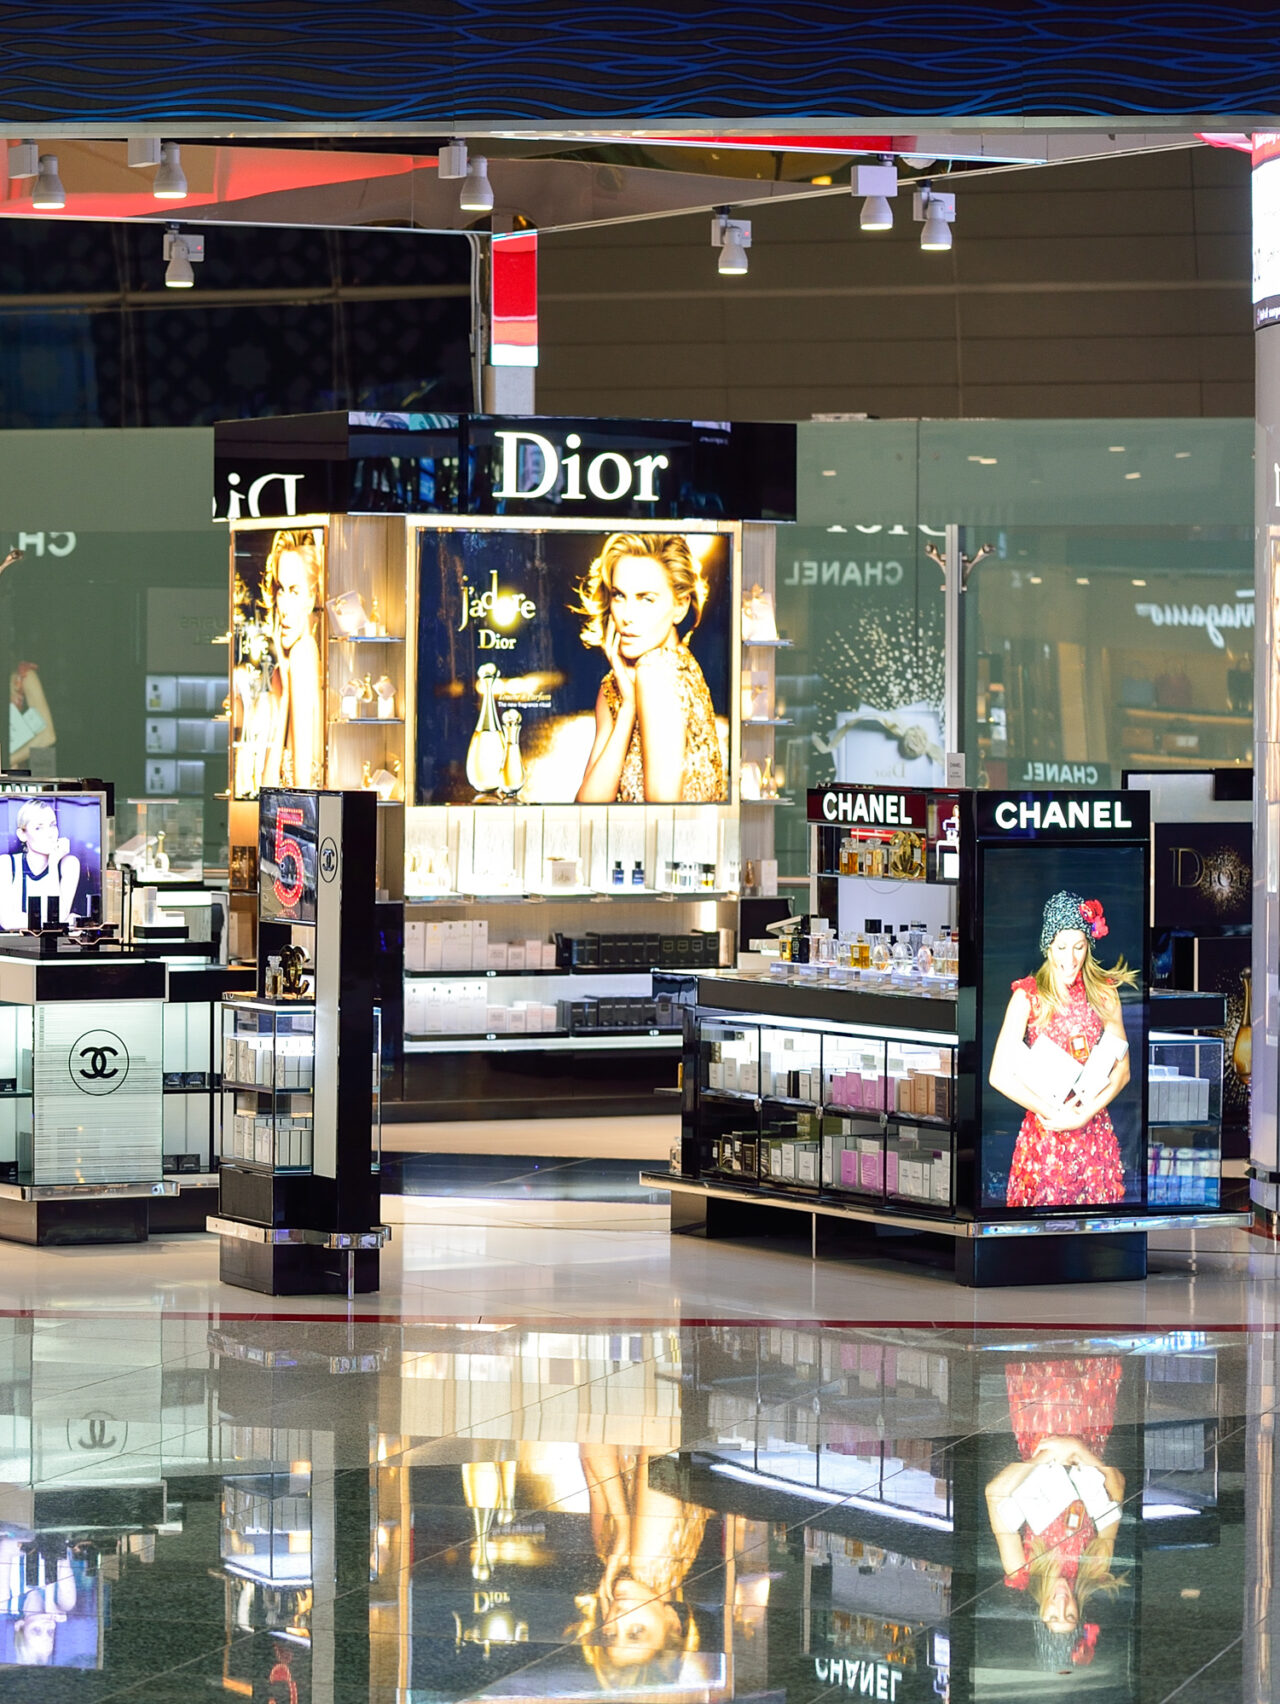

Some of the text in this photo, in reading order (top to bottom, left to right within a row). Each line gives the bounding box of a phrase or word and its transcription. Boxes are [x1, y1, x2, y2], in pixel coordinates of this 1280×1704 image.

[491, 431, 669, 502] Dior
[477, 628, 517, 650] Dior
[822, 792, 912, 825] CHANEL
[995, 801, 1132, 829] CHANEL
